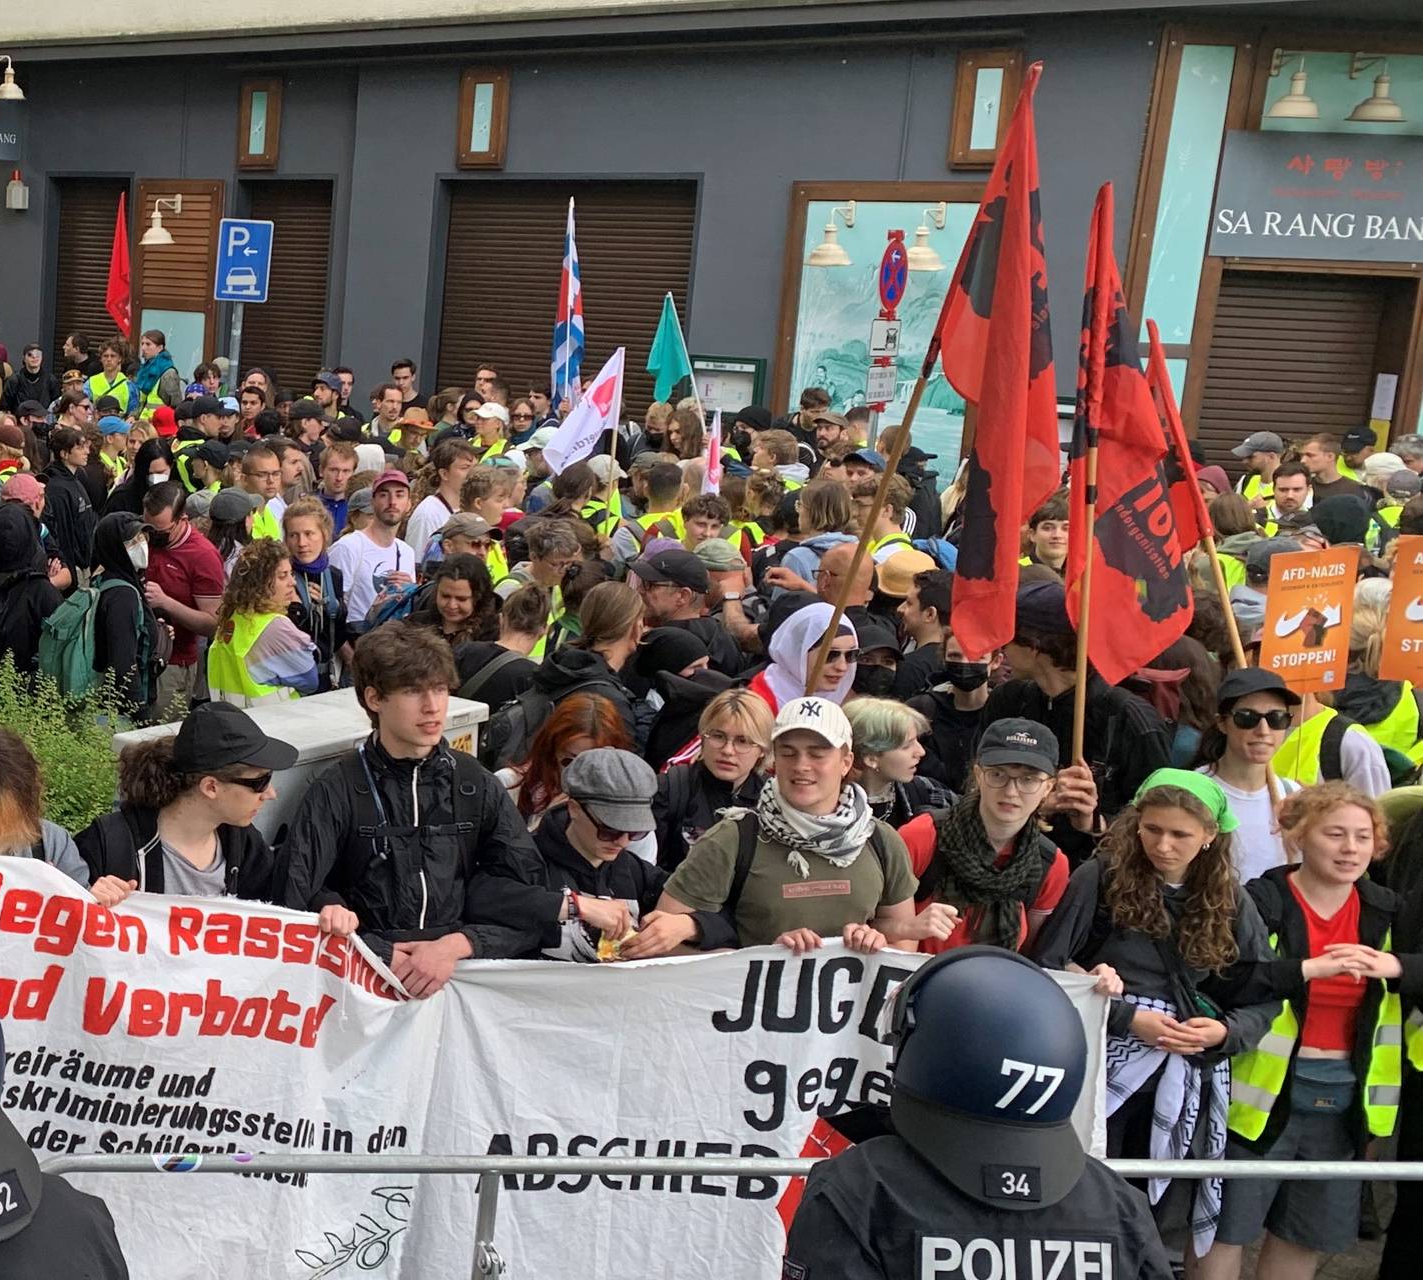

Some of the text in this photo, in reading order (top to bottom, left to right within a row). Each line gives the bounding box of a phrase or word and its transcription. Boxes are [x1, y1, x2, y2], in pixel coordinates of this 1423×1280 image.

[1216, 208, 1254, 235] SA
[1261, 211, 1357, 239] RANG
[227, 226, 251, 257] P
[1281, 562, 1347, 582] AFD-NAZIS
[1271, 648, 1337, 669] STOPPEN!
[711, 956, 913, 1044] JUGE
[4, 1045, 216, 1099] reiräume und
[995, 1058, 1066, 1116] 77
[27, 1120, 87, 1155] der
[322, 1122, 353, 1153] in
[475, 1131, 781, 1201] ABSCHIEB
[1000, 1172, 1031, 1196] 34
[921, 1236, 1113, 1280] POLIZEI
